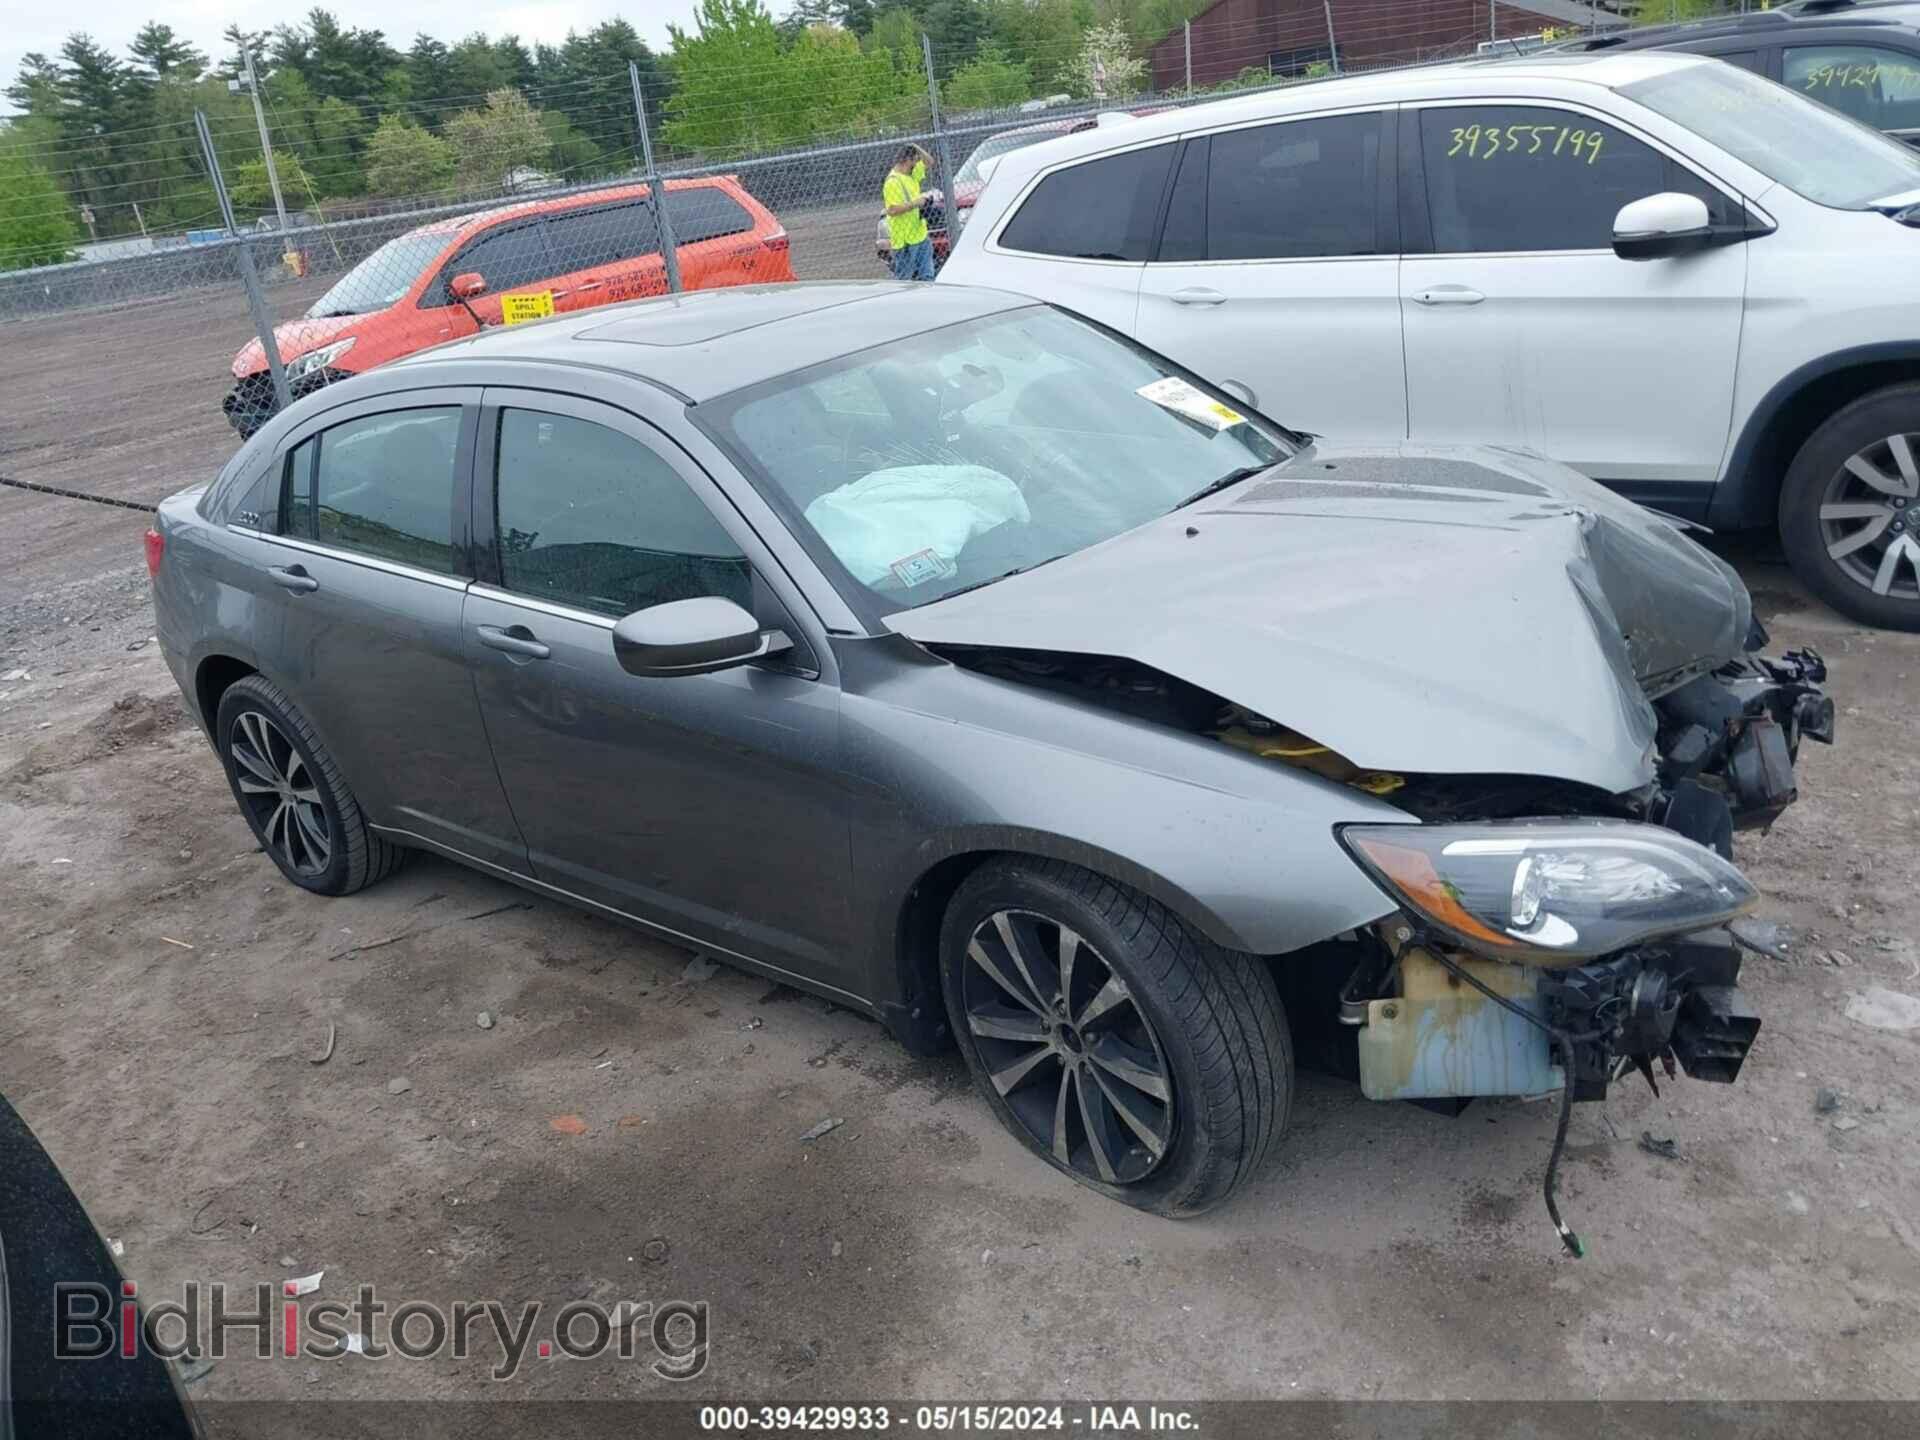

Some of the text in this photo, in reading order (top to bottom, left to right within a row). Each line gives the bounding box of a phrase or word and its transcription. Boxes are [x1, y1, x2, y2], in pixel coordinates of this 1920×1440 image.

[1448, 124, 1603, 164] 39355199
[514, 303, 536, 311] SPILL
[511, 312, 542, 320] STATION
